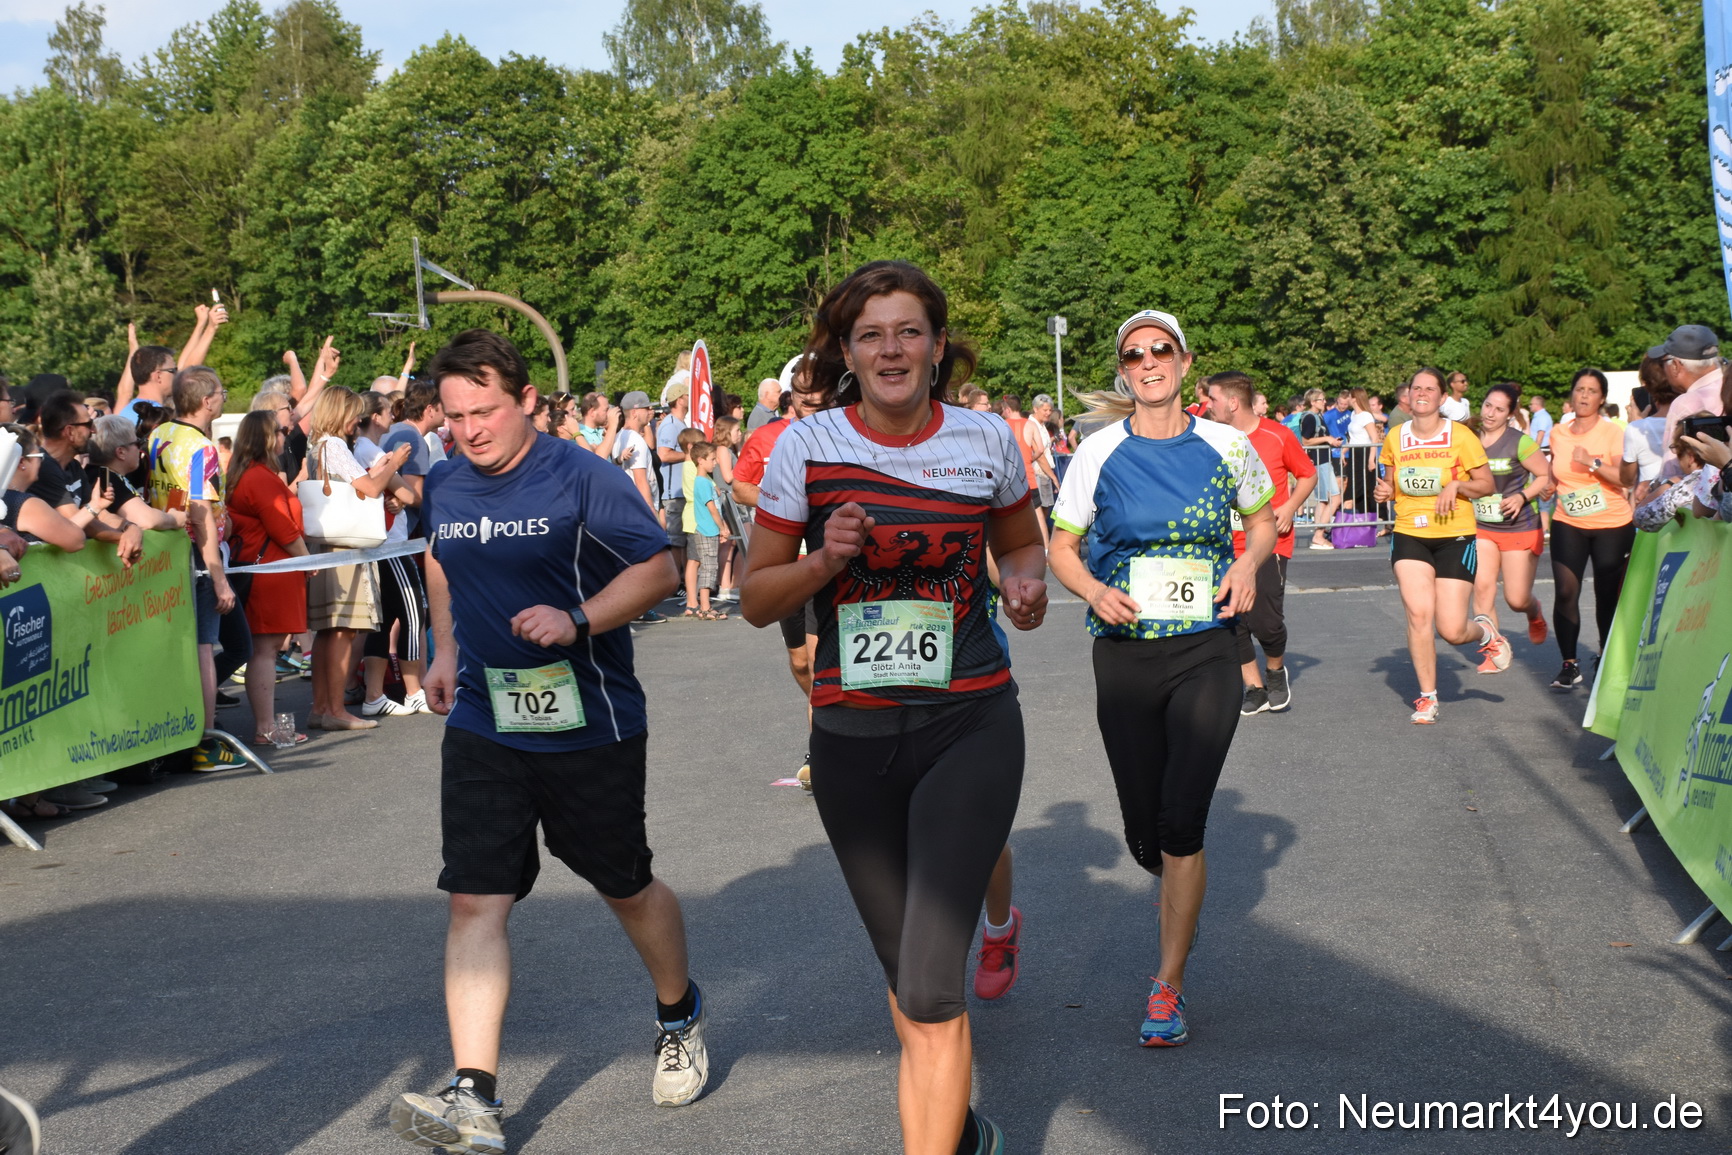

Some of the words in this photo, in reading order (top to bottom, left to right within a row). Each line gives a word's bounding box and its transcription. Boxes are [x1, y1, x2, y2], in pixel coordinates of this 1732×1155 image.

[1400, 452, 1421, 463] MAX
[1424, 450, 1452, 460] BÖGL
[922, 467, 982, 478] NEUMARKT
[1404, 478, 1435, 490] 1627
[1567, 494, 1600, 512] 2302
[438, 522, 478, 540] EURO
[493, 517, 550, 538] POLES
[1147, 580, 1195, 603] 226
[13, 616, 45, 640] Fischer
[926, 624, 946, 632] 2019
[852, 630, 938, 665] 2246
[871, 662, 896, 672] Glötzl
[898, 662, 921, 671] Anita
[506, 690, 560, 715] 702
[0, 725, 35, 757] markt
